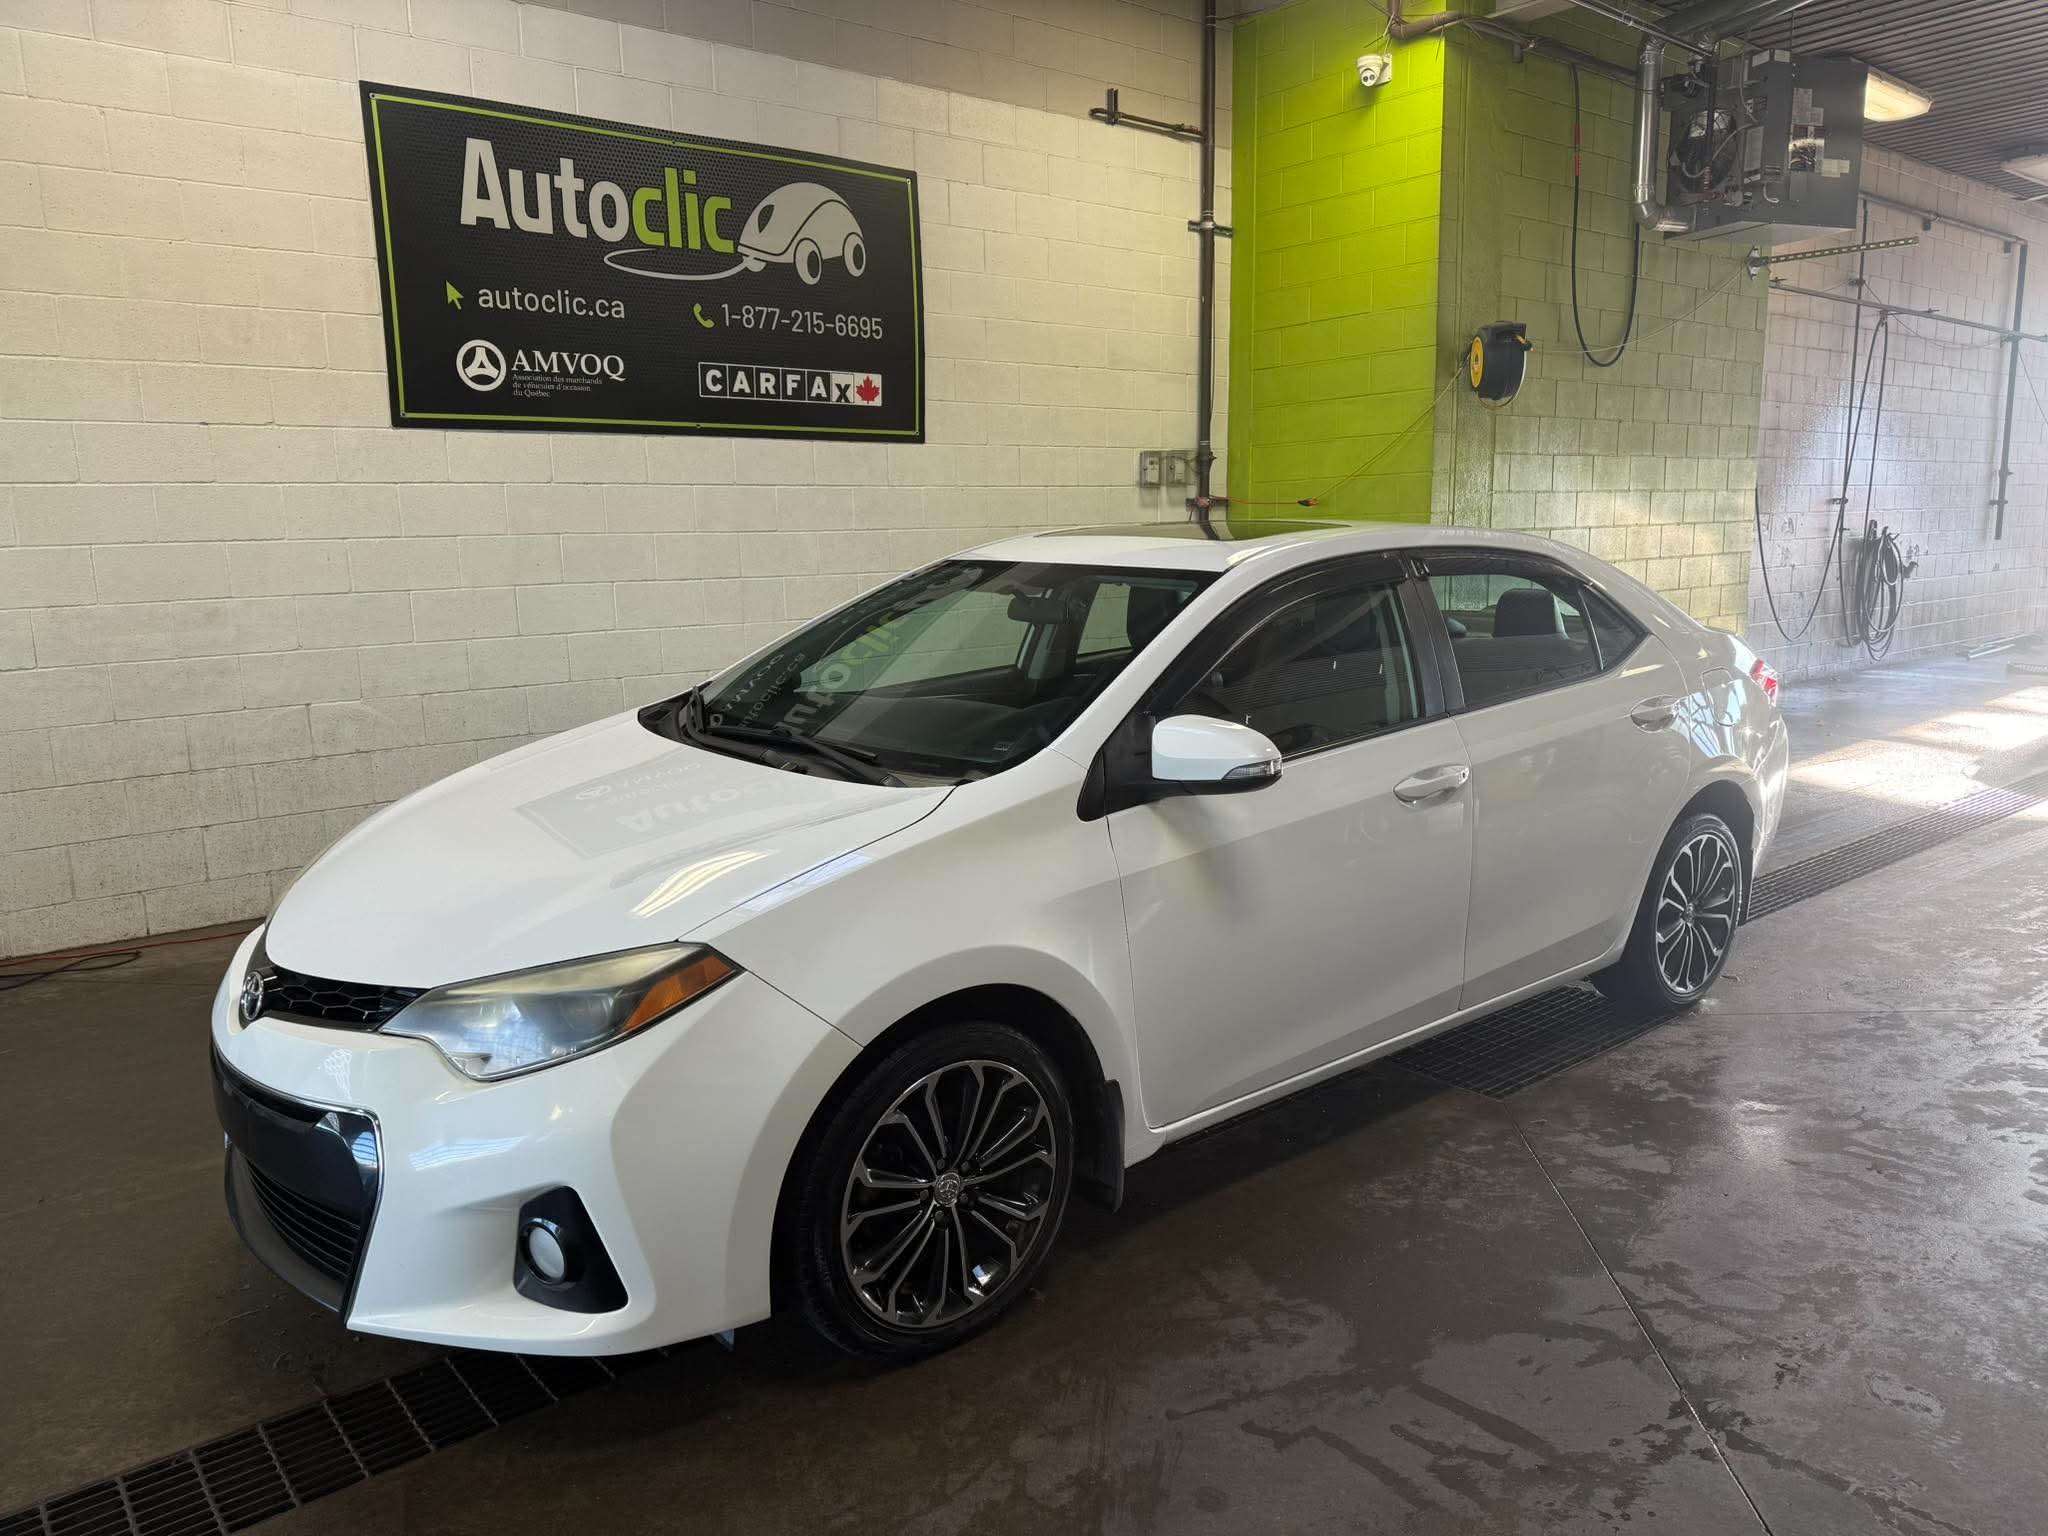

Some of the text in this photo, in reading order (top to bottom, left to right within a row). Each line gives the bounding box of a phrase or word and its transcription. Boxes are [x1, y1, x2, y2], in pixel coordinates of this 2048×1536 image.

[460, 137, 735, 255] Autoclic
[478, 287, 625, 319] autoclic.ca
[721, 303, 883, 340] 1-877-215-6695
[511, 349, 627, 382] AMVOQ
[705, 368, 852, 404] CARFAX
